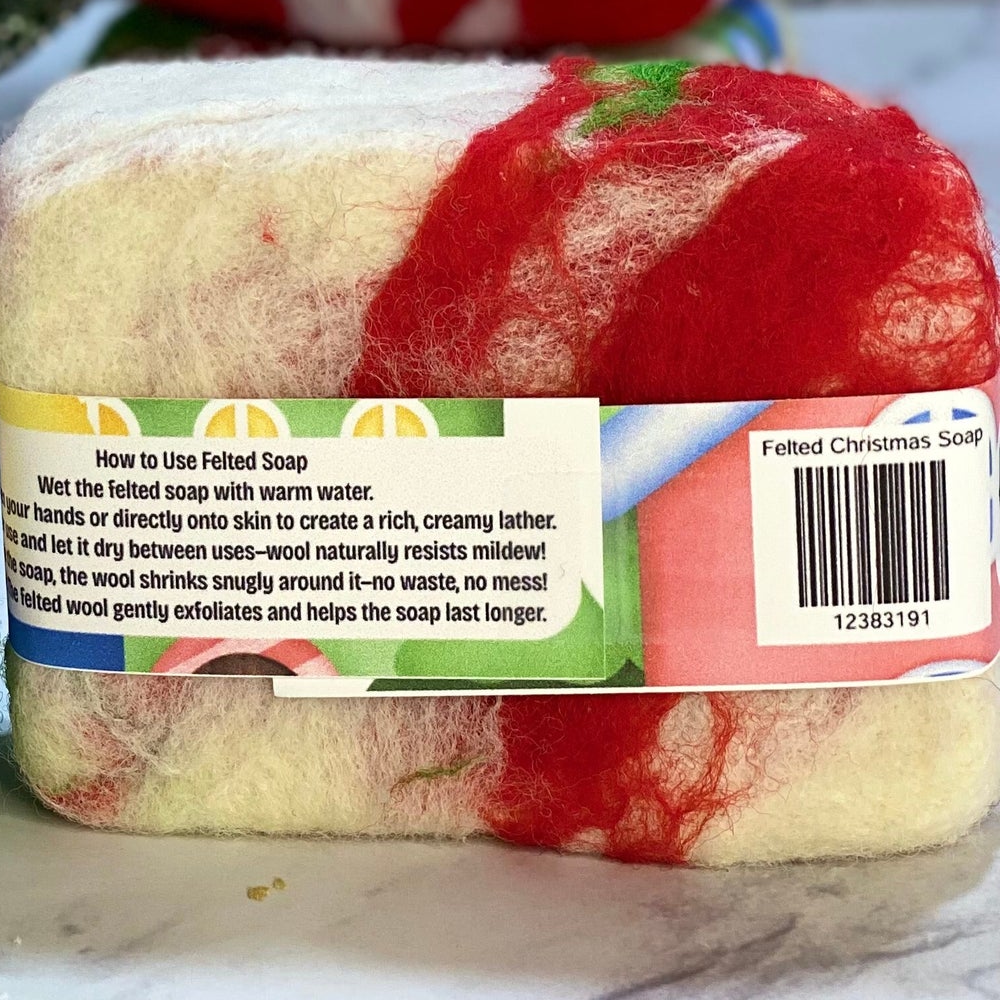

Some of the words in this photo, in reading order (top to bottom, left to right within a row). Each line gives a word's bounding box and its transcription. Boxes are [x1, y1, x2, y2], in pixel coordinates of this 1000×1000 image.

[762, 439, 823, 456] Felted
[830, 436, 931, 454] Christmas
[938, 427, 983, 448] Soap
[96, 450, 135, 468] How
[140, 452, 157, 469] to
[164, 451, 197, 470] Use
[202, 451, 256, 470] Felted
[262, 452, 308, 474] Soap
[38, 475, 71, 496] Wet
[75, 478, 103, 498] the
[108, 480, 160, 499] felted
[165, 485, 209, 504] soap
[213, 482, 254, 500] with
[260, 486, 312, 500] warm
[317, 483, 373, 500] water.
[6, 495, 30, 519] your
[34, 502, 85, 526] hands
[90, 512, 108, 526] or
[113, 509, 182, 533] directly
[188, 512, 228, 530] onto
[234, 511, 271, 530] skin
[276, 513, 294, 530] to
[300, 513, 358, 530] create
[363, 515, 373, 529] a
[379, 511, 418, 532] rich,
[423, 515, 493, 533] creamy
[499, 510, 556, 529] lather.
[21, 533, 47, 552] and
[52, 535, 73, 555] let
[77, 537, 89, 556] it
[94, 538, 124, 561] dry
[129, 539, 207, 560] between
[316, 541, 398, 564] naturally
[405, 541, 467, 560] resists
[473, 541, 545, 560] mildew!
[19, 561, 56, 586] soap,
[60, 566, 88, 586] the
[92, 570, 134, 588] wool
[140, 570, 208, 590] shrinks
[213, 572, 273, 594] snugly
[279, 572, 343, 591] around
[400, 573, 459, 593] waste,
[465, 576, 487, 591] no
[493, 573, 547, 591] mess!
[20, 587, 61, 613] felted
[66, 598, 108, 617] wool
[113, 600, 168, 623] gently
[174, 601, 262, 621] exfoliates
[268, 602, 301, 621] and
[307, 602, 357, 625] helps
[362, 602, 391, 621] the
[396, 606, 440, 625] soap
[446, 602, 480, 621] last
[486, 603, 546, 625] longer.
[834, 609, 930, 630] 12383191
